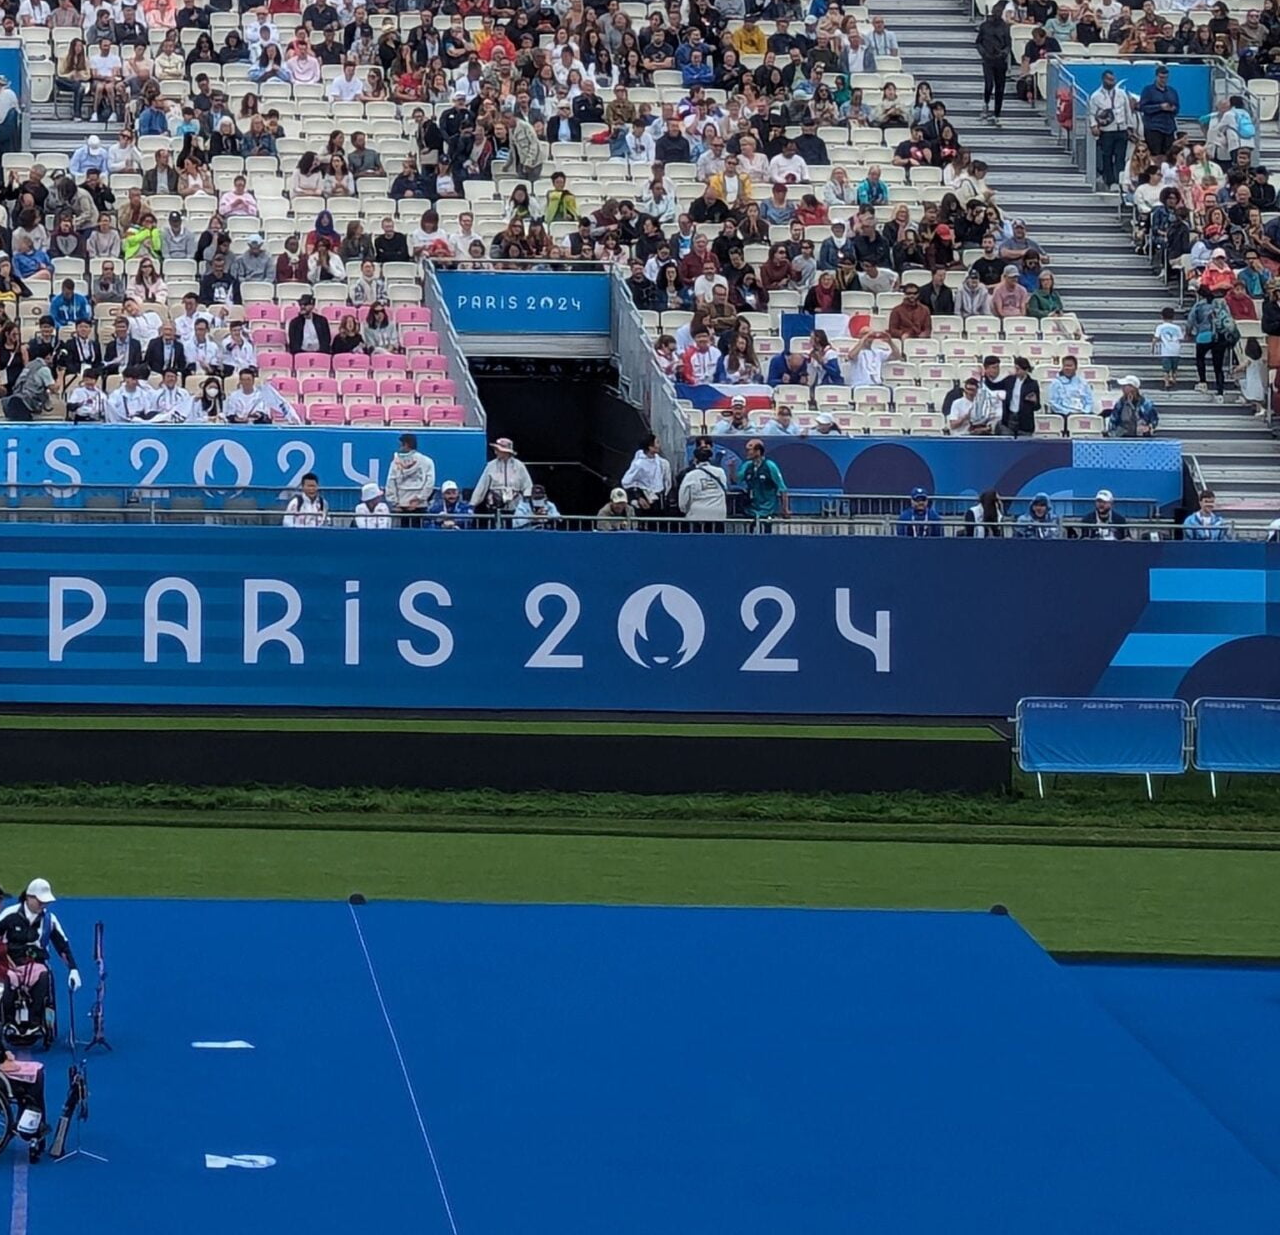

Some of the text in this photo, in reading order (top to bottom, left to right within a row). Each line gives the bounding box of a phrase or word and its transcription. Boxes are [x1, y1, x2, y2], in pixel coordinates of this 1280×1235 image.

[458, 295, 581, 311] PARIS 2024
[48, 576, 890, 672] PARIS 2024
